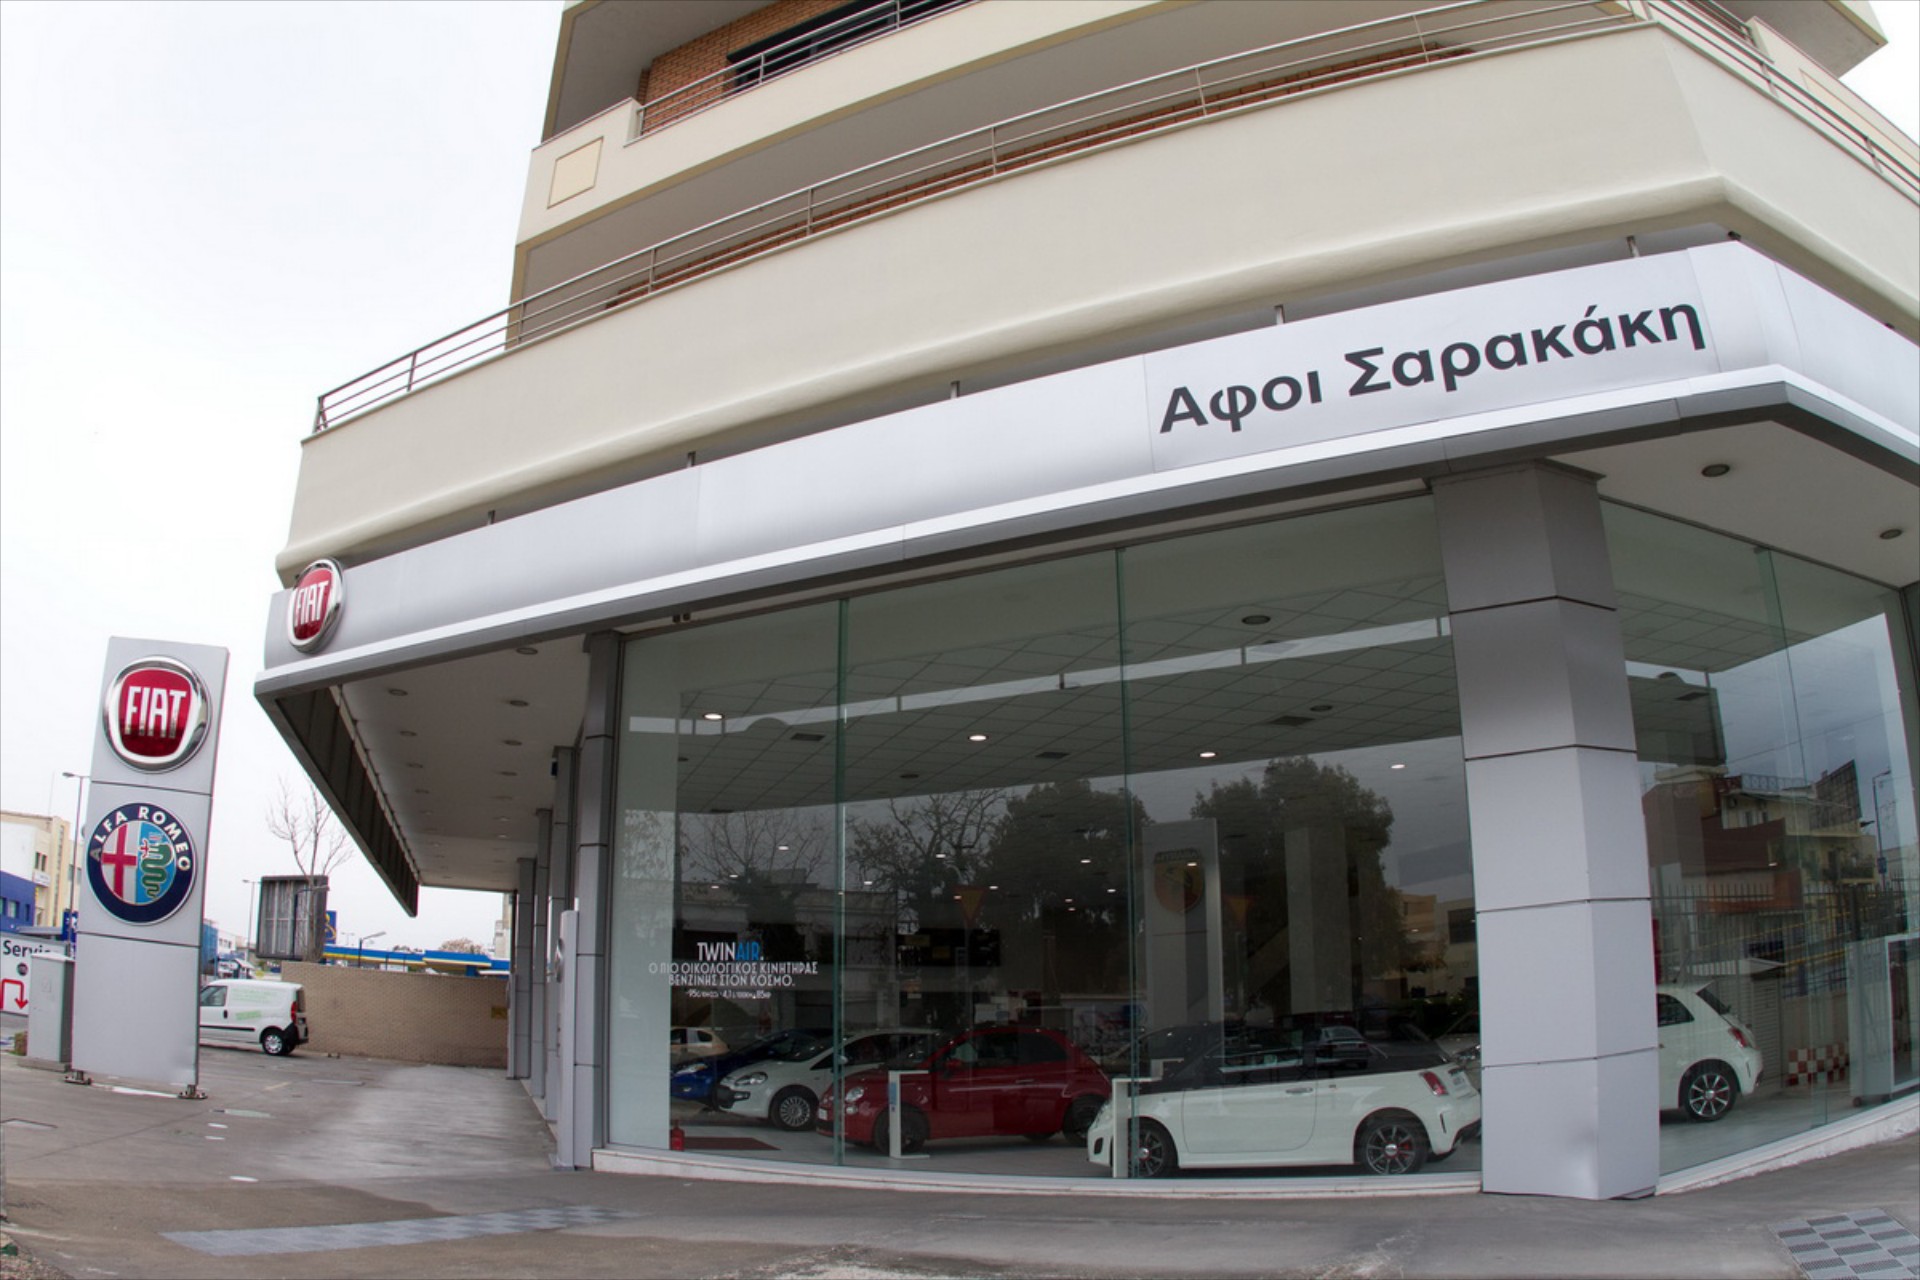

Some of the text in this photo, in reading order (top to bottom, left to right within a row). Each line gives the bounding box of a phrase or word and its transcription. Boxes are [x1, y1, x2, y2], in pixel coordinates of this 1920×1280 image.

[1159, 302, 1706, 433] Αφοι Σαρακάκη
[293, 580, 330, 628] FIAT
[124, 685, 187, 739] FIAT
[89, 804, 191, 872] ALFA ROMEO
[3, 940, 52, 957] Servi
